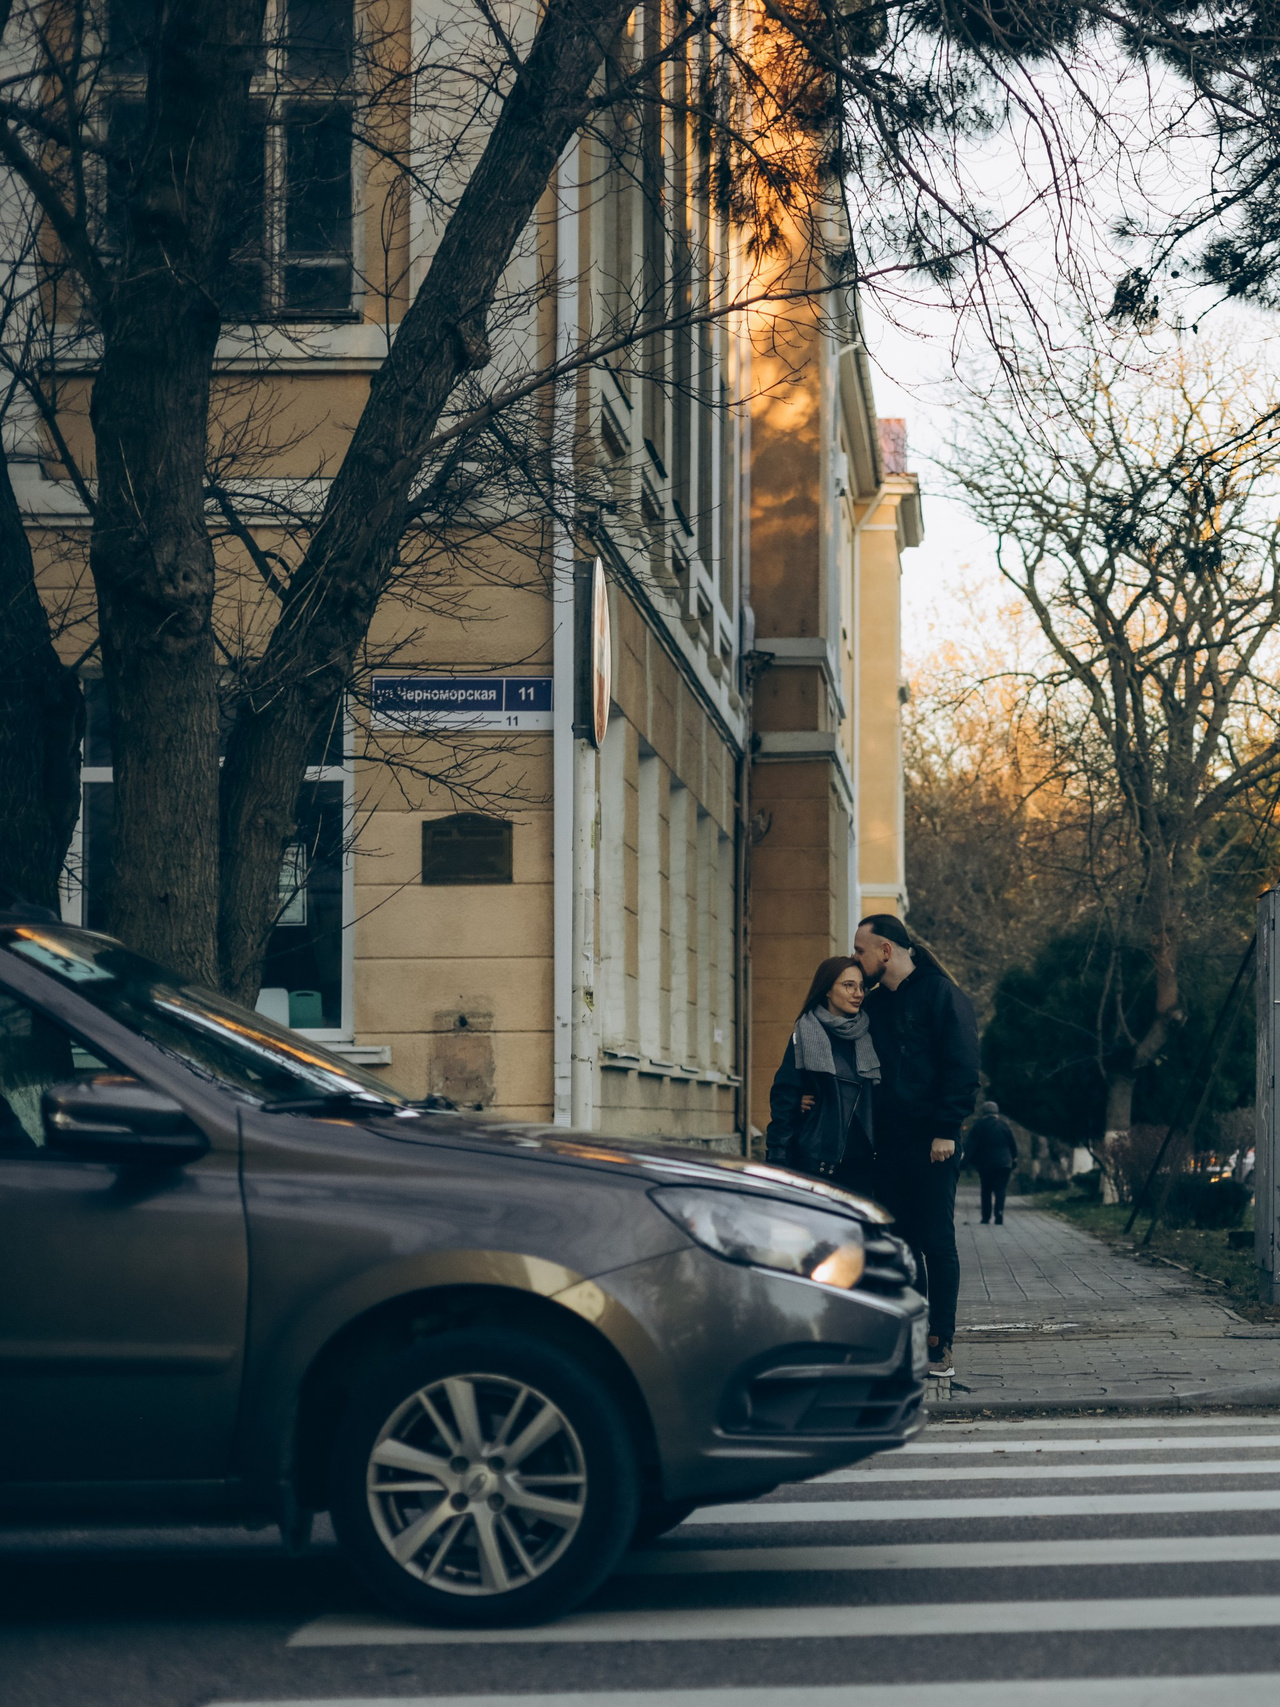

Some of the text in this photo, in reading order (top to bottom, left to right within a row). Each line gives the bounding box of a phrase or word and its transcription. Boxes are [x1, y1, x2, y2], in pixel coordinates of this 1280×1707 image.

[397, 686, 497, 703] Черноморская
[518, 686, 534, 701] 11
[506, 715, 518, 726] 11
